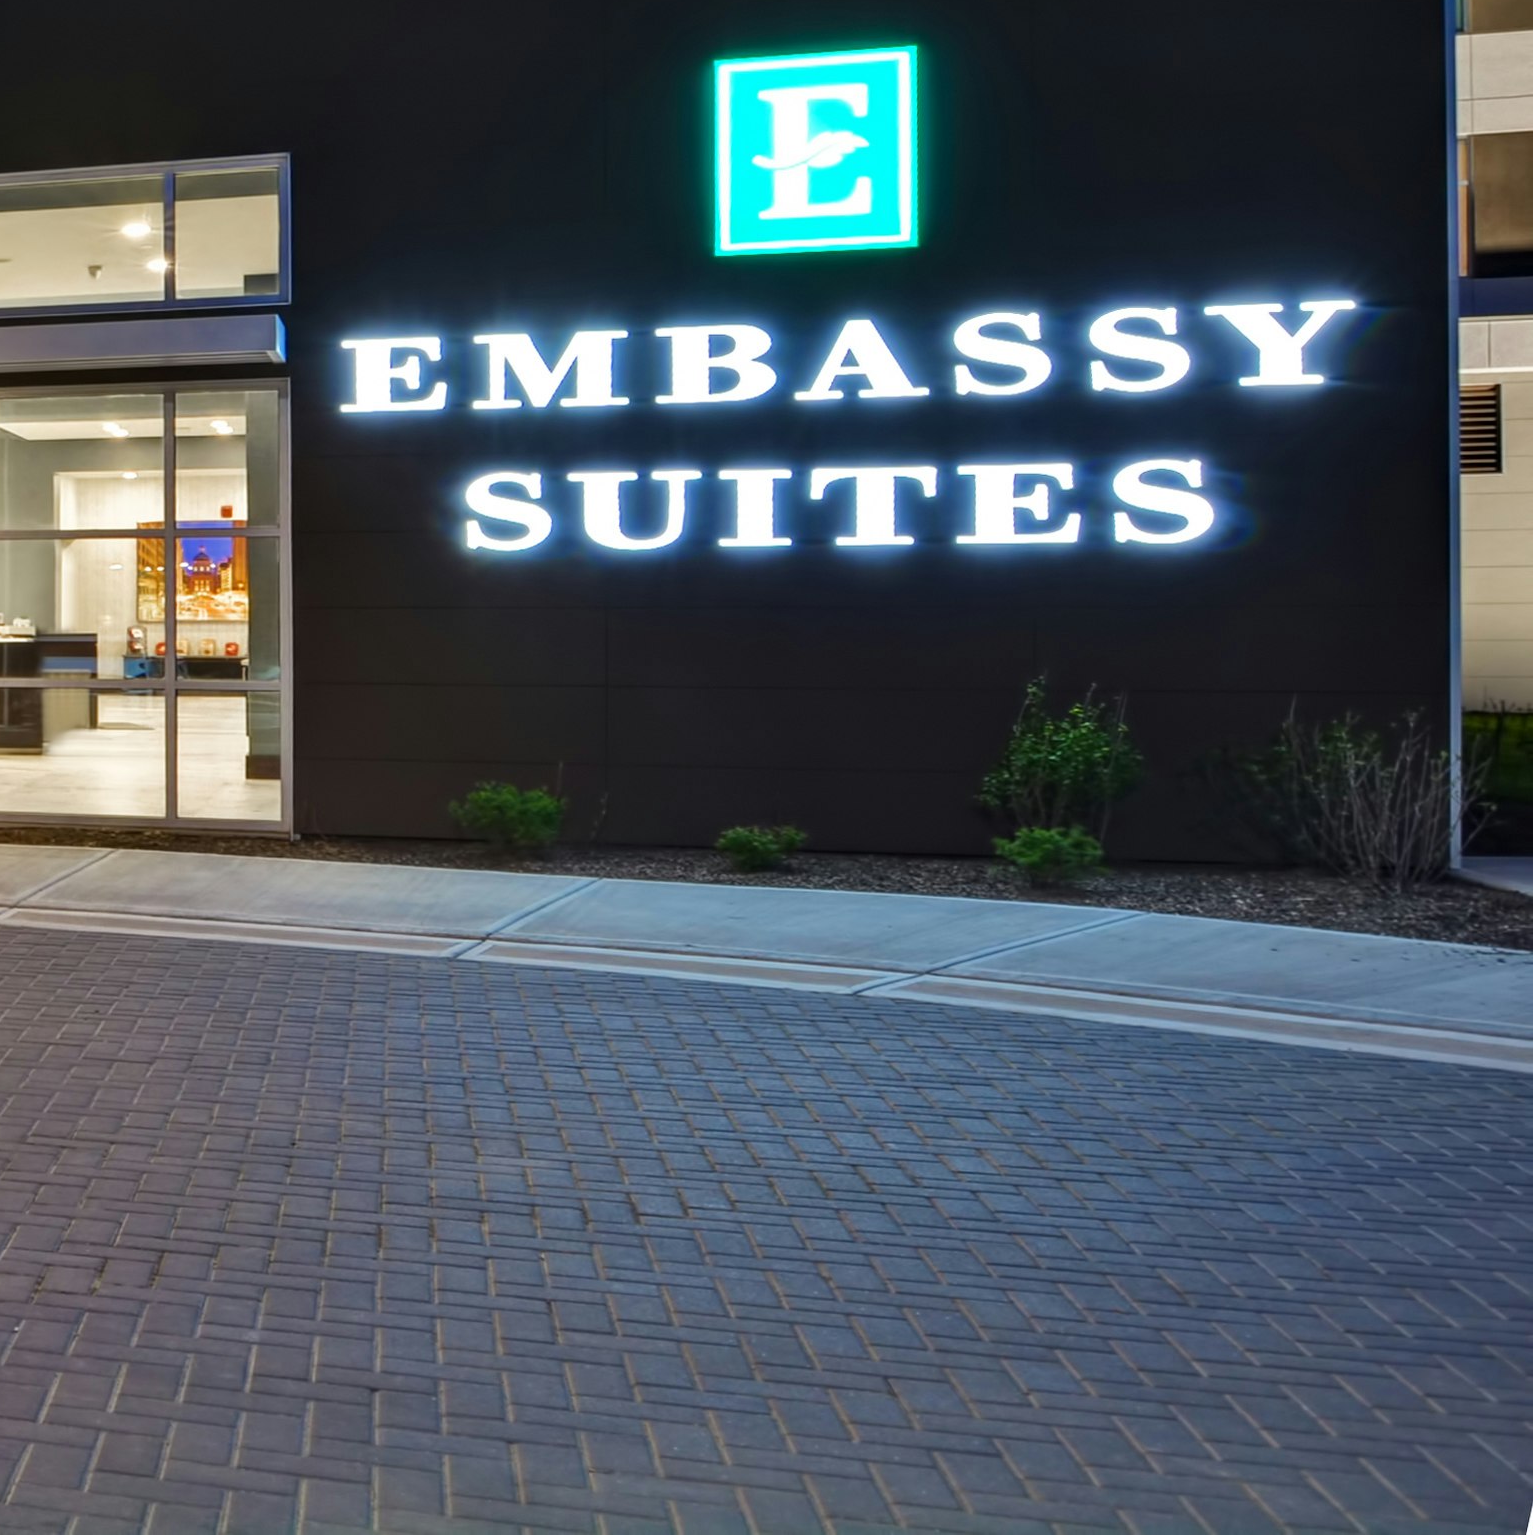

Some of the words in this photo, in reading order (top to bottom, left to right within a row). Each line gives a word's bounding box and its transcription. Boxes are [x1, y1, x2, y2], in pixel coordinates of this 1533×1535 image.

[754, 84, 870, 218] E
[340, 300, 1355, 413] EMBASSY
[465, 458, 1214, 551] SUITES
